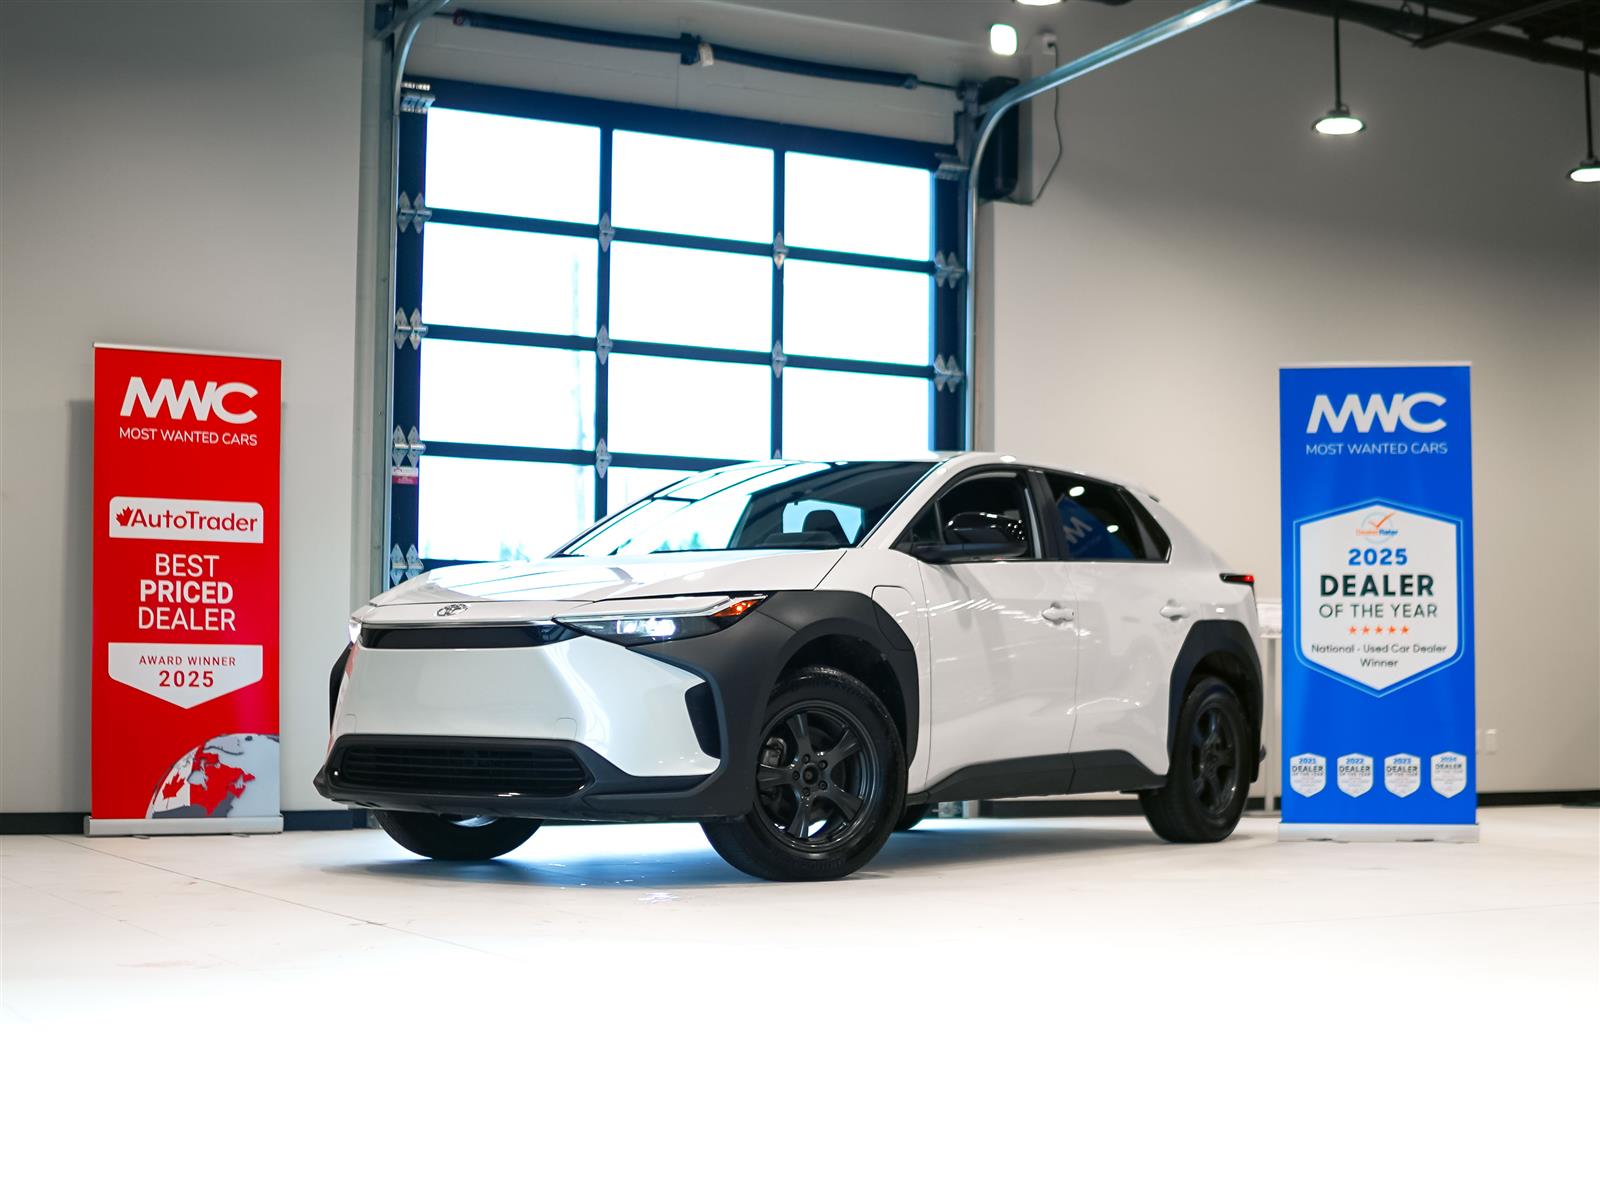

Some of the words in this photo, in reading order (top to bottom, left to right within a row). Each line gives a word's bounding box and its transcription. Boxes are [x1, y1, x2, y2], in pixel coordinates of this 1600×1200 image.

[120, 376, 259, 425] MWC
[1305, 391, 1448, 434] MWC
[119, 426, 157, 441] MOST
[160, 429, 219, 444] WANTED
[222, 432, 258, 447] CARS
[1305, 443, 1344, 455] MOST
[1347, 442, 1408, 455] WANTED
[1410, 442, 1448, 454] CARS
[130, 508, 258, 532] AutoTrader
[155, 553, 220, 578] BEST
[1348, 548, 1408, 566] 2025
[140, 580, 234, 605] PRICED
[1320, 574, 1434, 597] DEALER
[138, 606, 236, 632] DEALER
[1318, 603, 1344, 619] OF
[1350, 603, 1384, 618] THE
[1390, 603, 1438, 618] YEAR
[1311, 644, 1355, 654] National
[1363, 644, 1389, 654] Used
[1391, 644, 1410, 654] Car
[1412, 643, 1447, 654] Dealer
[138, 655, 183, 666] AWARD
[187, 656, 236, 667] WINNER
[1360, 658, 1399, 668] Winner
[159, 670, 214, 688] 2025
